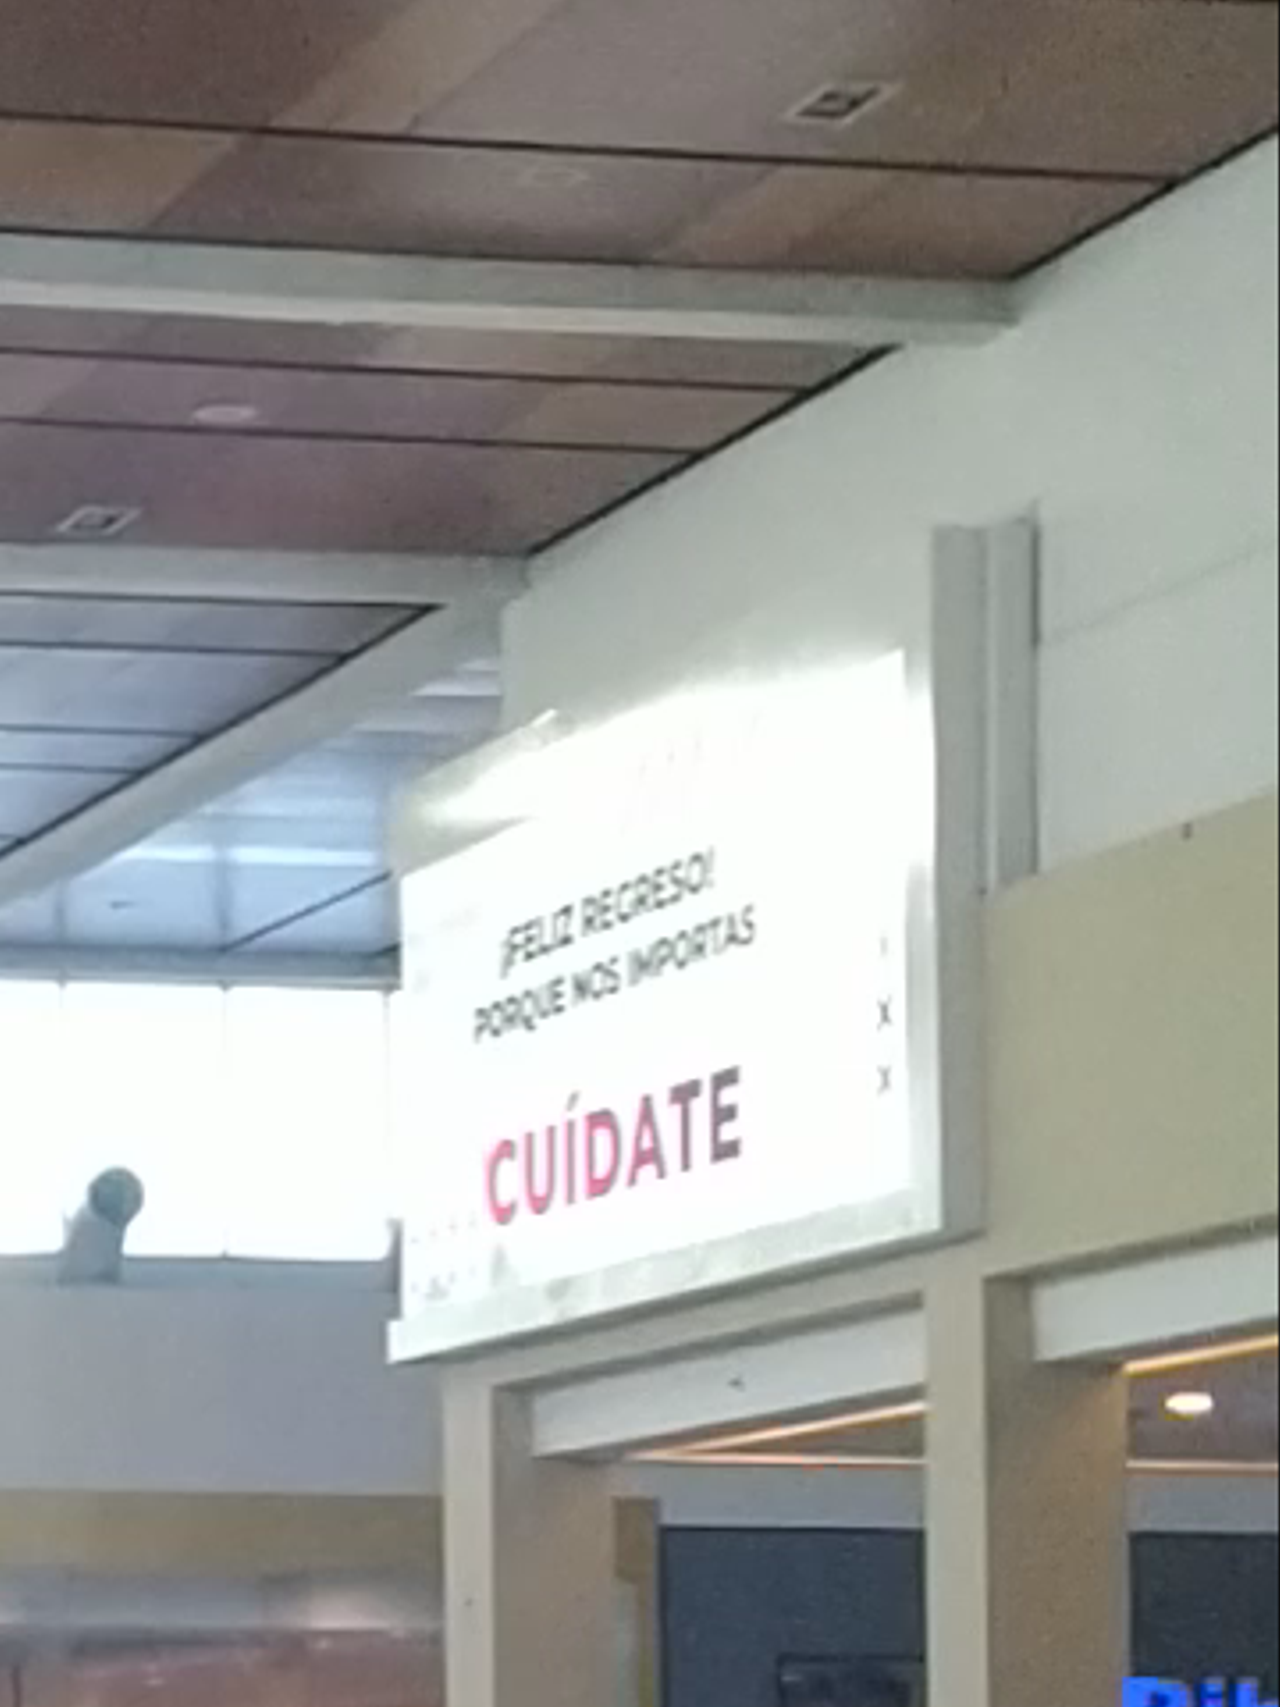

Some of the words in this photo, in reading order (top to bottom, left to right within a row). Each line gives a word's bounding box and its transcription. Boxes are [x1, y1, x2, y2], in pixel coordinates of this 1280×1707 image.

[474, 976, 565, 1044] PORQUE
[571, 955, 621, 1007] NOS
[627, 903, 755, 987] IMPORTAS
[500, 904, 573, 980] ¡FELIZ
[581, 845, 715, 937] REGRESO!
[484, 1065, 741, 1225] CUÍDATE
